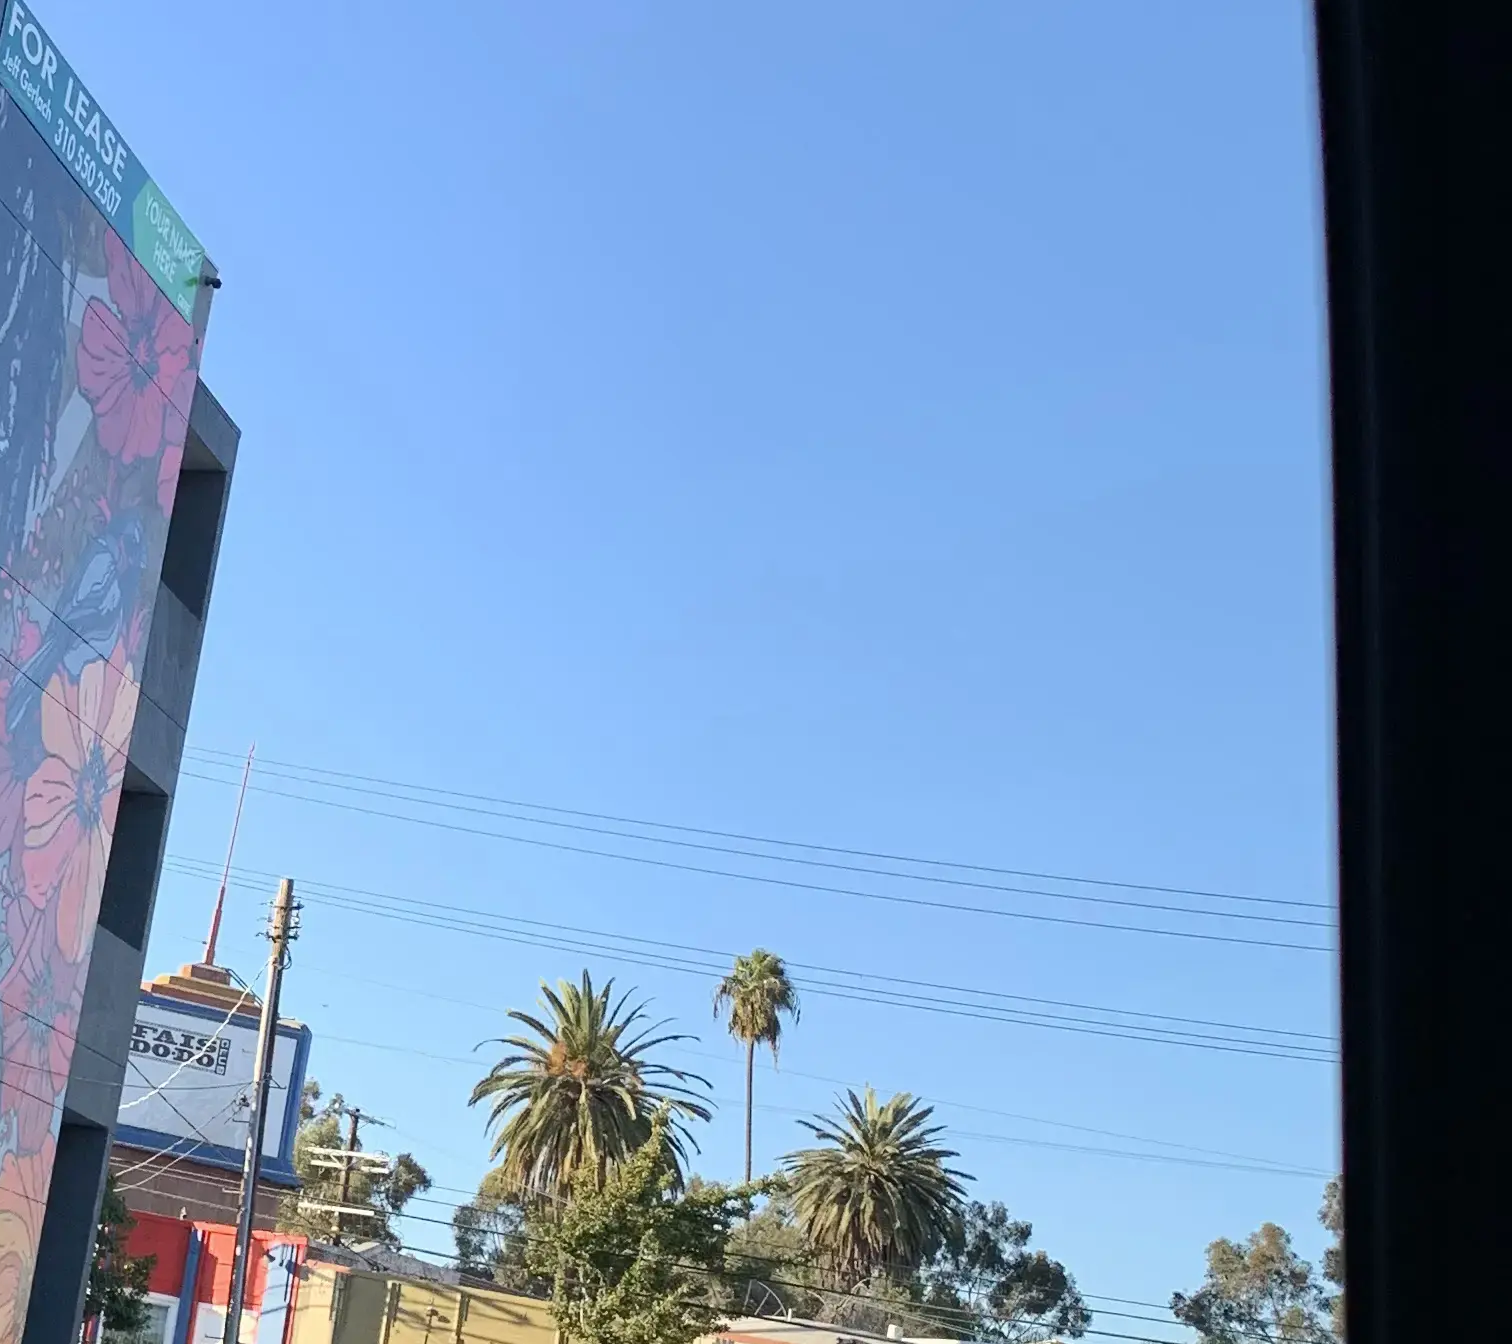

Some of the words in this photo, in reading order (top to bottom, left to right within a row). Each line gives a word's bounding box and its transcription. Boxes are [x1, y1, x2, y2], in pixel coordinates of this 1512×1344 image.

[1, 46, 21, 80] Jeff
[20, 68, 53, 123] Gerlach
[53, 118, 76, 162] 310
[74, 149, 97, 188] 550
[93, 171, 123, 218] 2507
[7, 1, 58, 91] FOR
[63, 77, 127, 183] LEASE
[144, 190, 171, 242] YOUR
[169, 223, 199, 274] NAME
[153, 240, 177, 284] HERE
[133, 1024, 217, 1053] FAIS
